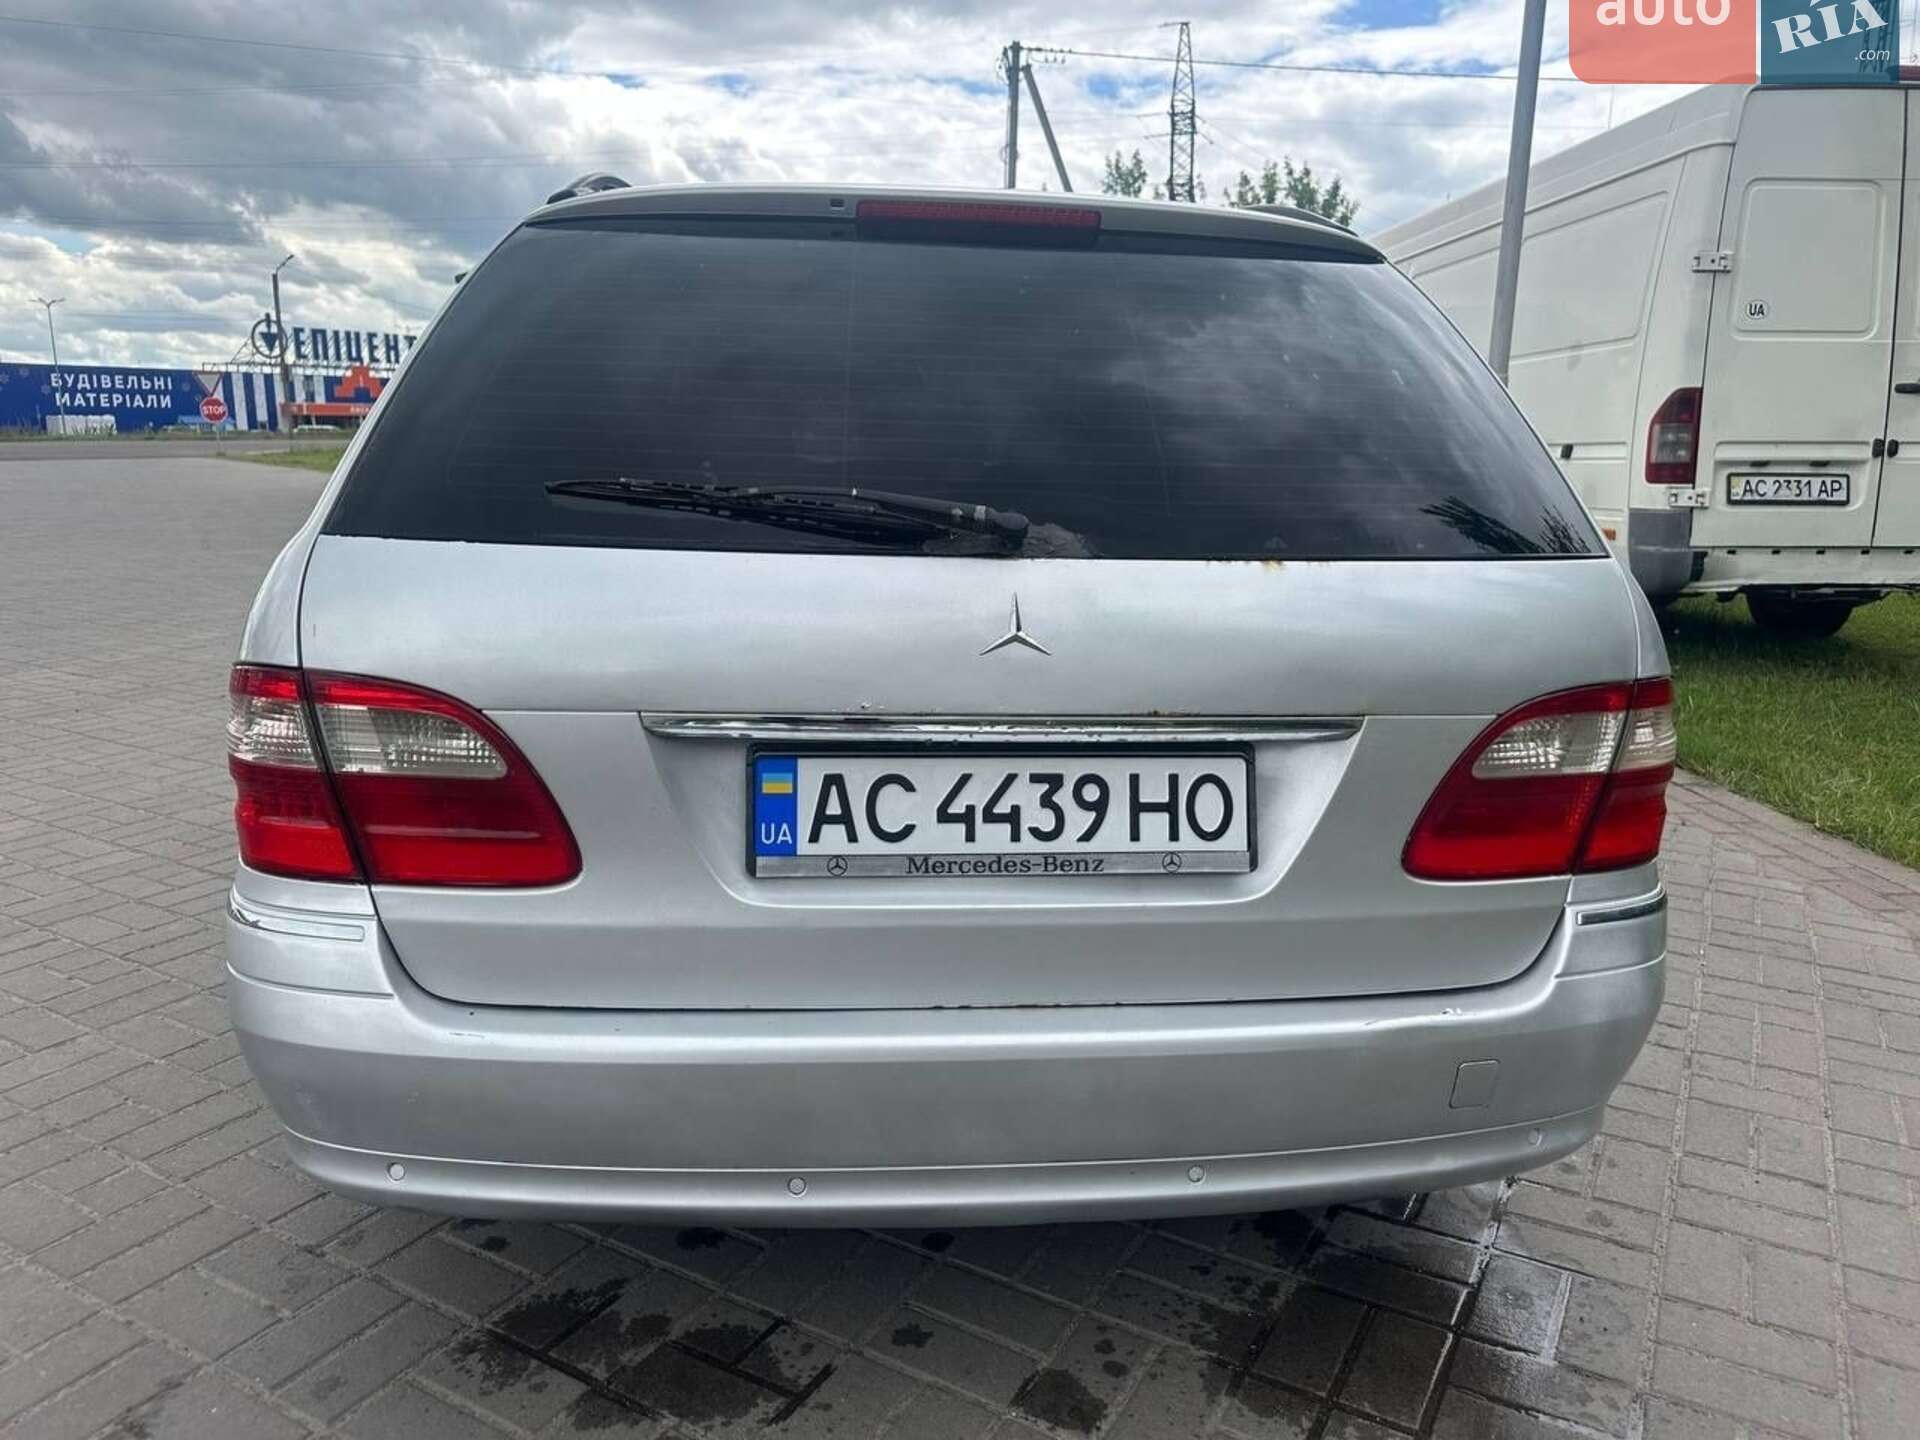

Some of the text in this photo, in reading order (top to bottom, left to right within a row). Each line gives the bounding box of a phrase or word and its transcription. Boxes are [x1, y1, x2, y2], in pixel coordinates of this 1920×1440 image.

[1749, 303, 1765, 316] UA
[51, 372, 173, 390] БУДІВЕЛЬНІ
[55, 393, 172, 409] МАТЕРІАЛИ
[202, 404, 226, 416] STOP
[1742, 479, 1767, 497] AC
[1817, 479, 1842, 497] AP
[808, 772, 1234, 843] AC 4439 HO
[761, 823, 793, 845] UA
[905, 855, 1105, 875] Mercedes-Benz
